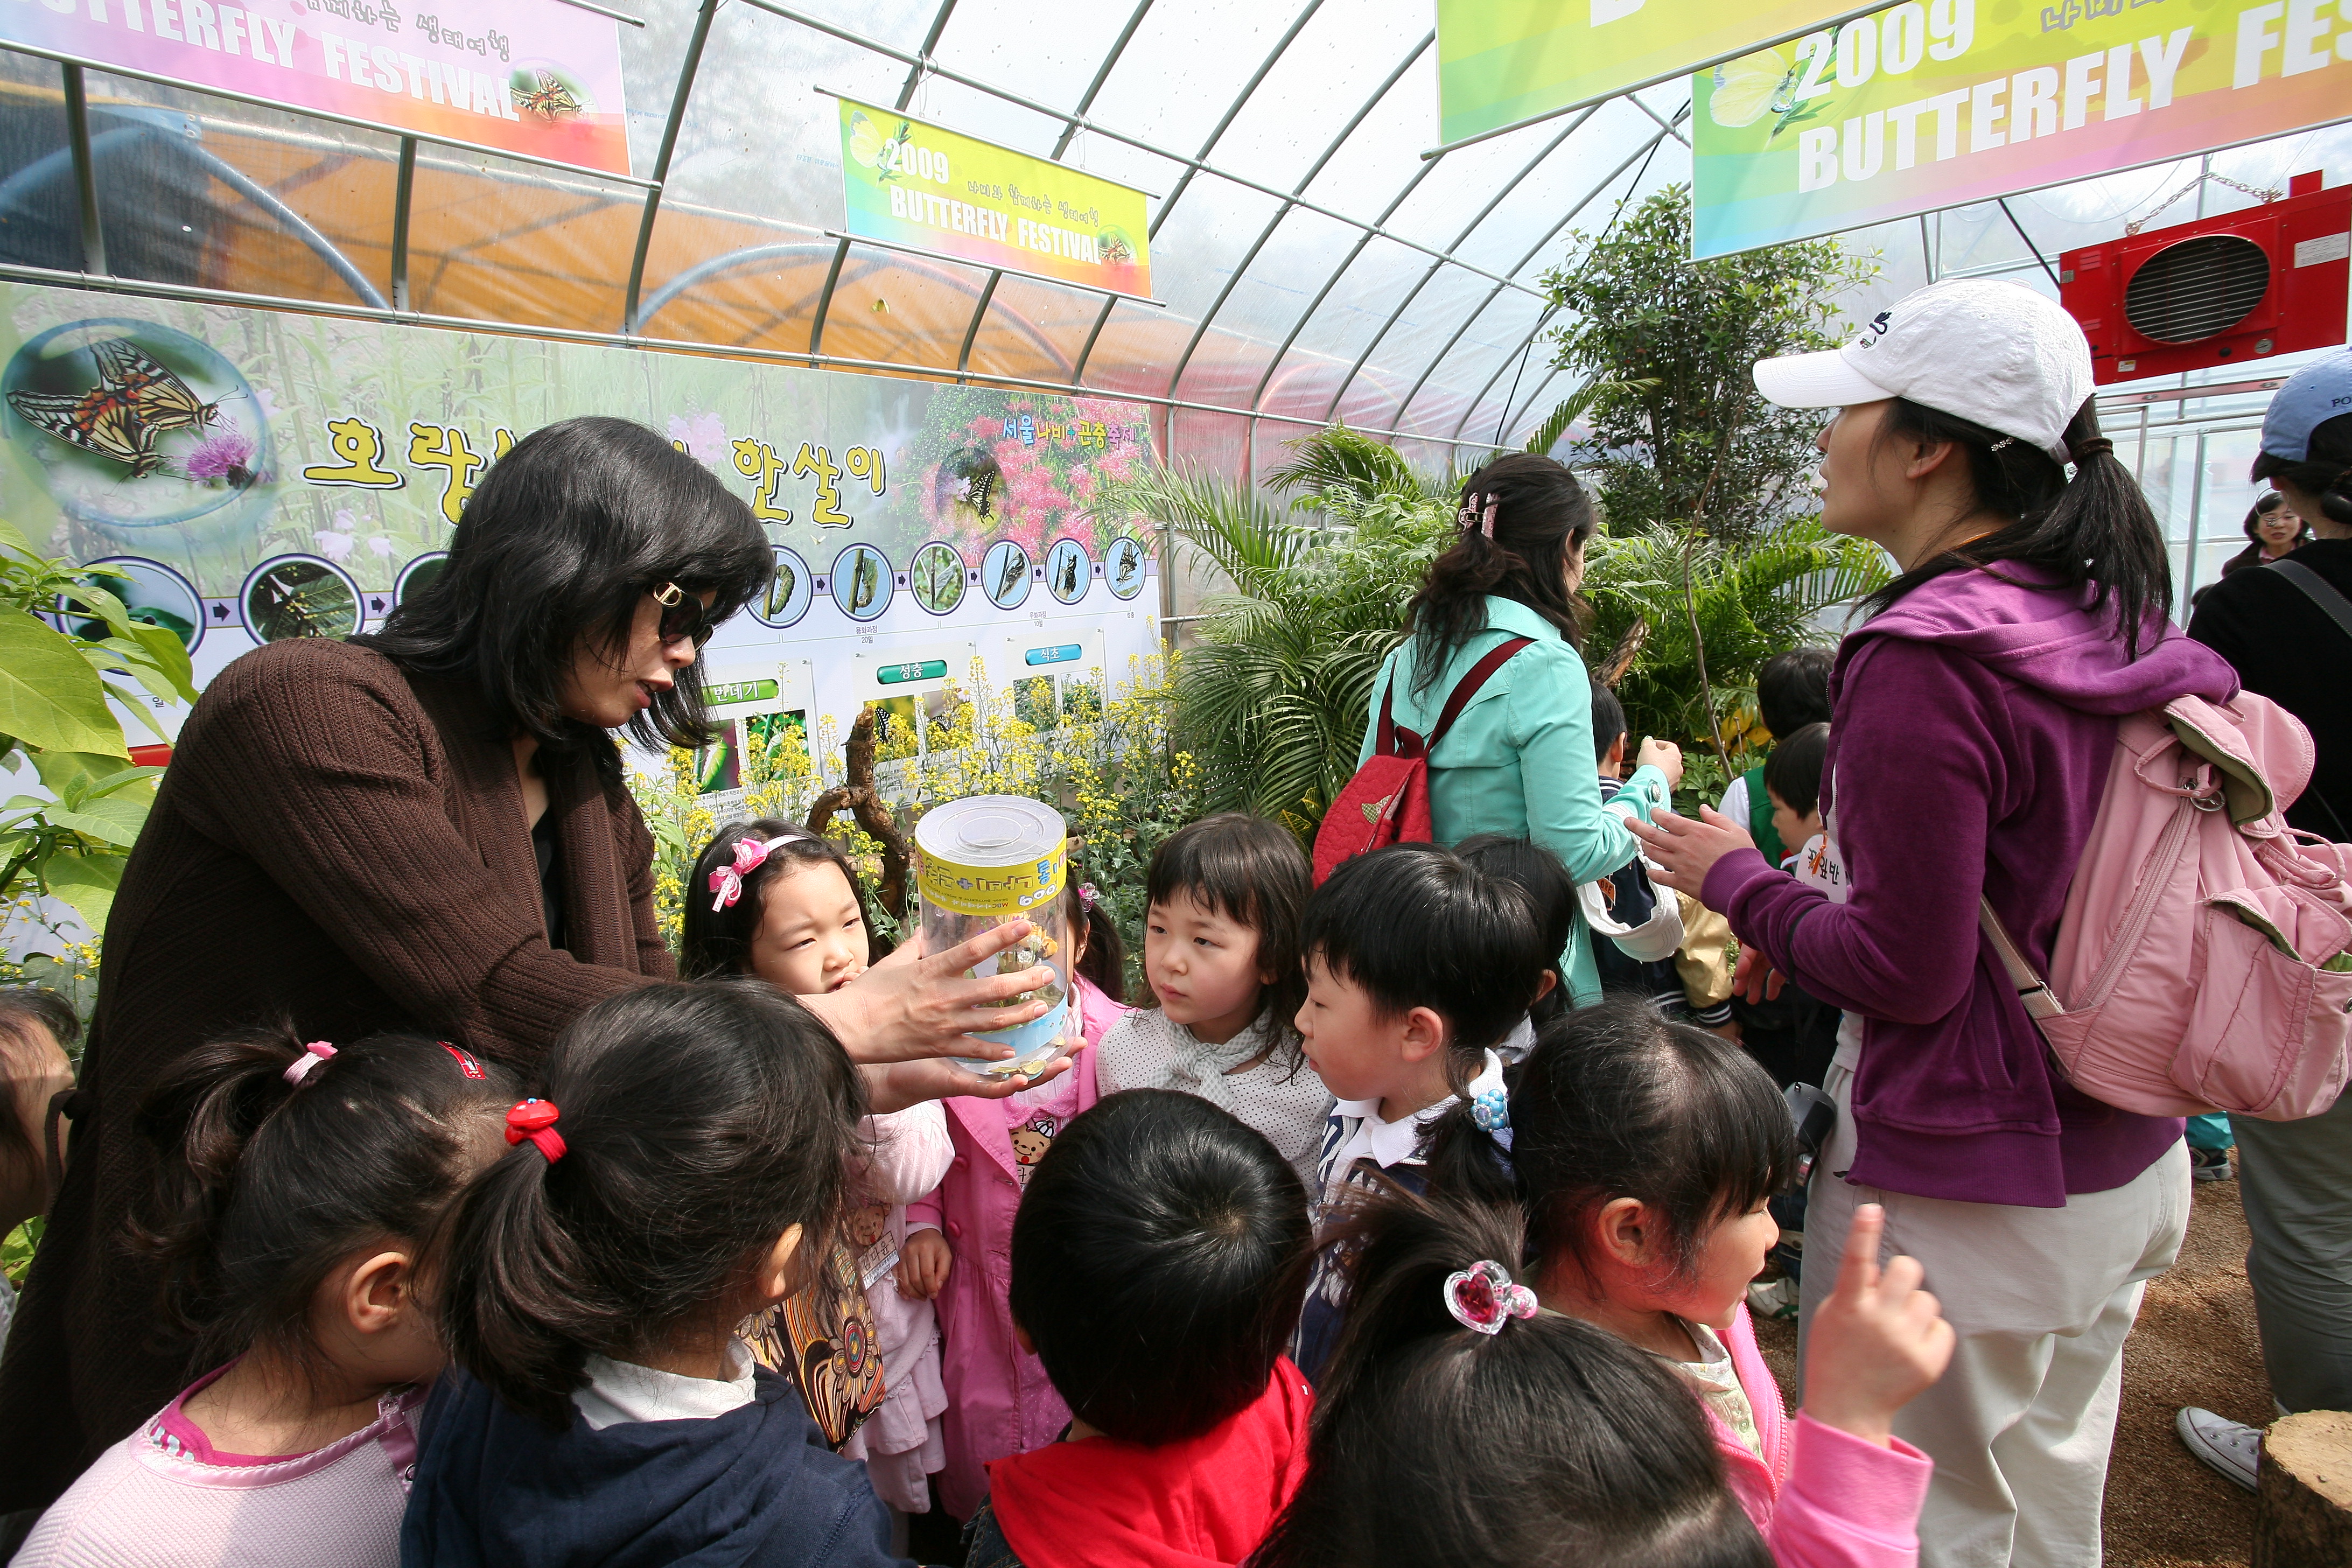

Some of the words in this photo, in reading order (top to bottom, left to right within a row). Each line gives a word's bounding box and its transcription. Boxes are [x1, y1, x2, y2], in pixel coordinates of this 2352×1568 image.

[416, 13, 510, 63] 생태여행
[2041, 0, 2167, 33] 나비
[1795, 0, 1975, 102] 2009
[321, 31, 520, 122] FESTIVAL
[1798, 26, 2193, 194] BUTTERFLY
[885, 138, 950, 184] 2009
[890, 184, 1009, 242] BUTTERFLY
[1018, 217, 1103, 265] FESTIVAL
[968, 181, 1003, 200] 나비와
[1009, 184, 1052, 214] 함께하는
[1058, 201, 1098, 227] 생태여행
[731, 437, 887, 530] 한살이
[899, 663, 924, 680] 성충
[1040, 647, 1061, 662] 식초
[712, 682, 760, 702] 번데기
